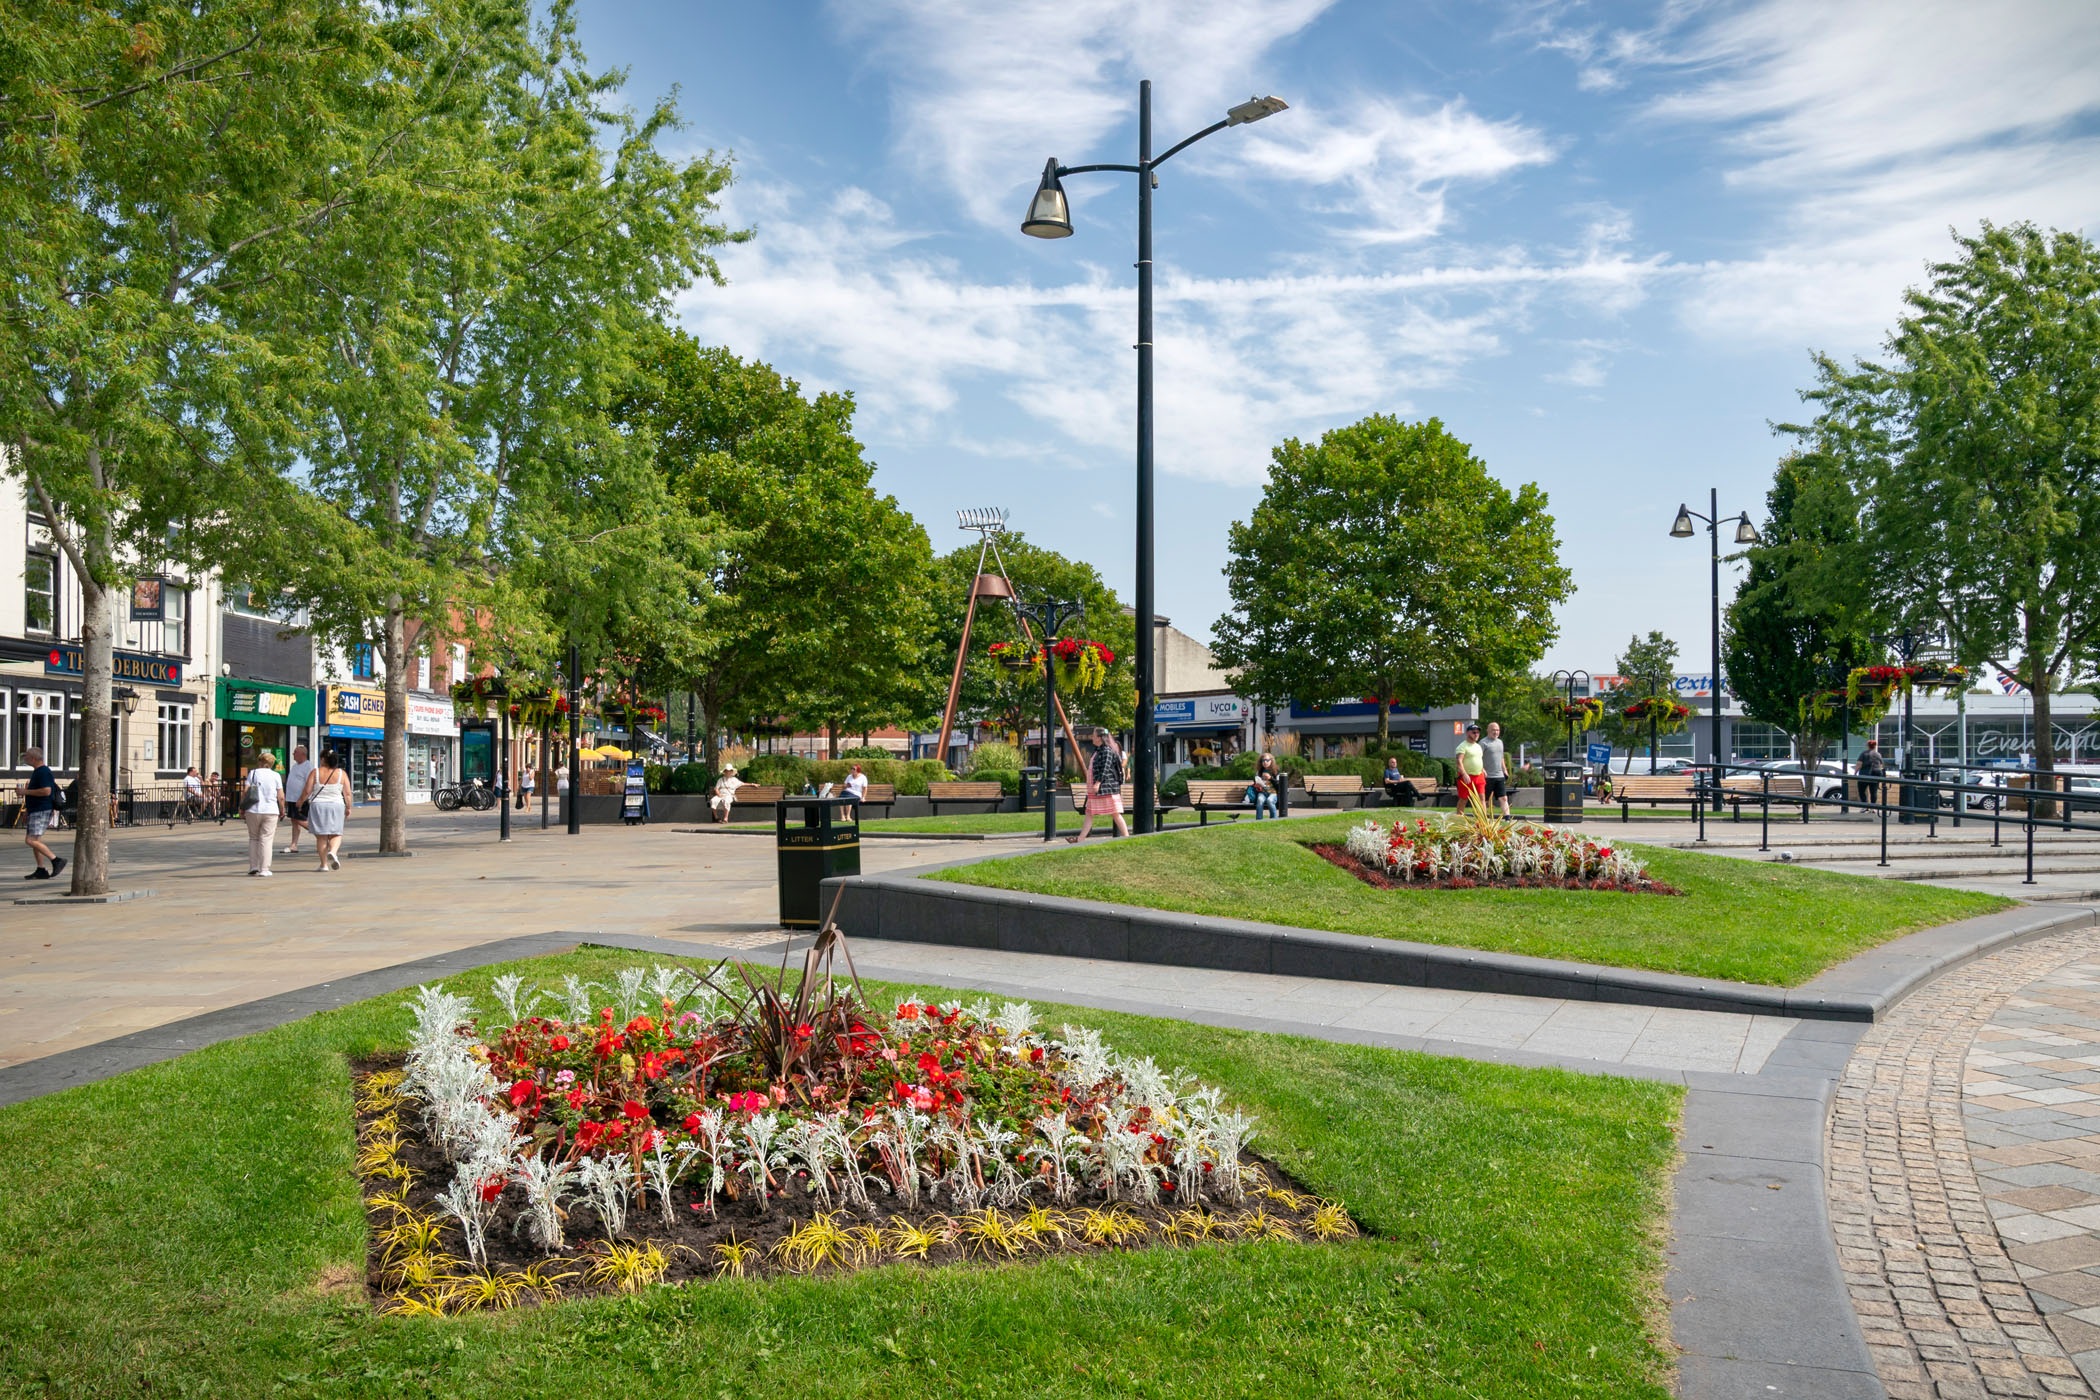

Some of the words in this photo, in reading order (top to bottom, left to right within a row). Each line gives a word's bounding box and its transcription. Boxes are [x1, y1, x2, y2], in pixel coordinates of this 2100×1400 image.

[66, 651, 84, 671] TH
[112, 658, 167, 680] OEBUCK
[258, 692, 297, 716] BWAY
[362, 698, 384, 712] GENER
[1160, 702, 1186, 711] MOBILES
[1210, 702, 1230, 712] Lyca
